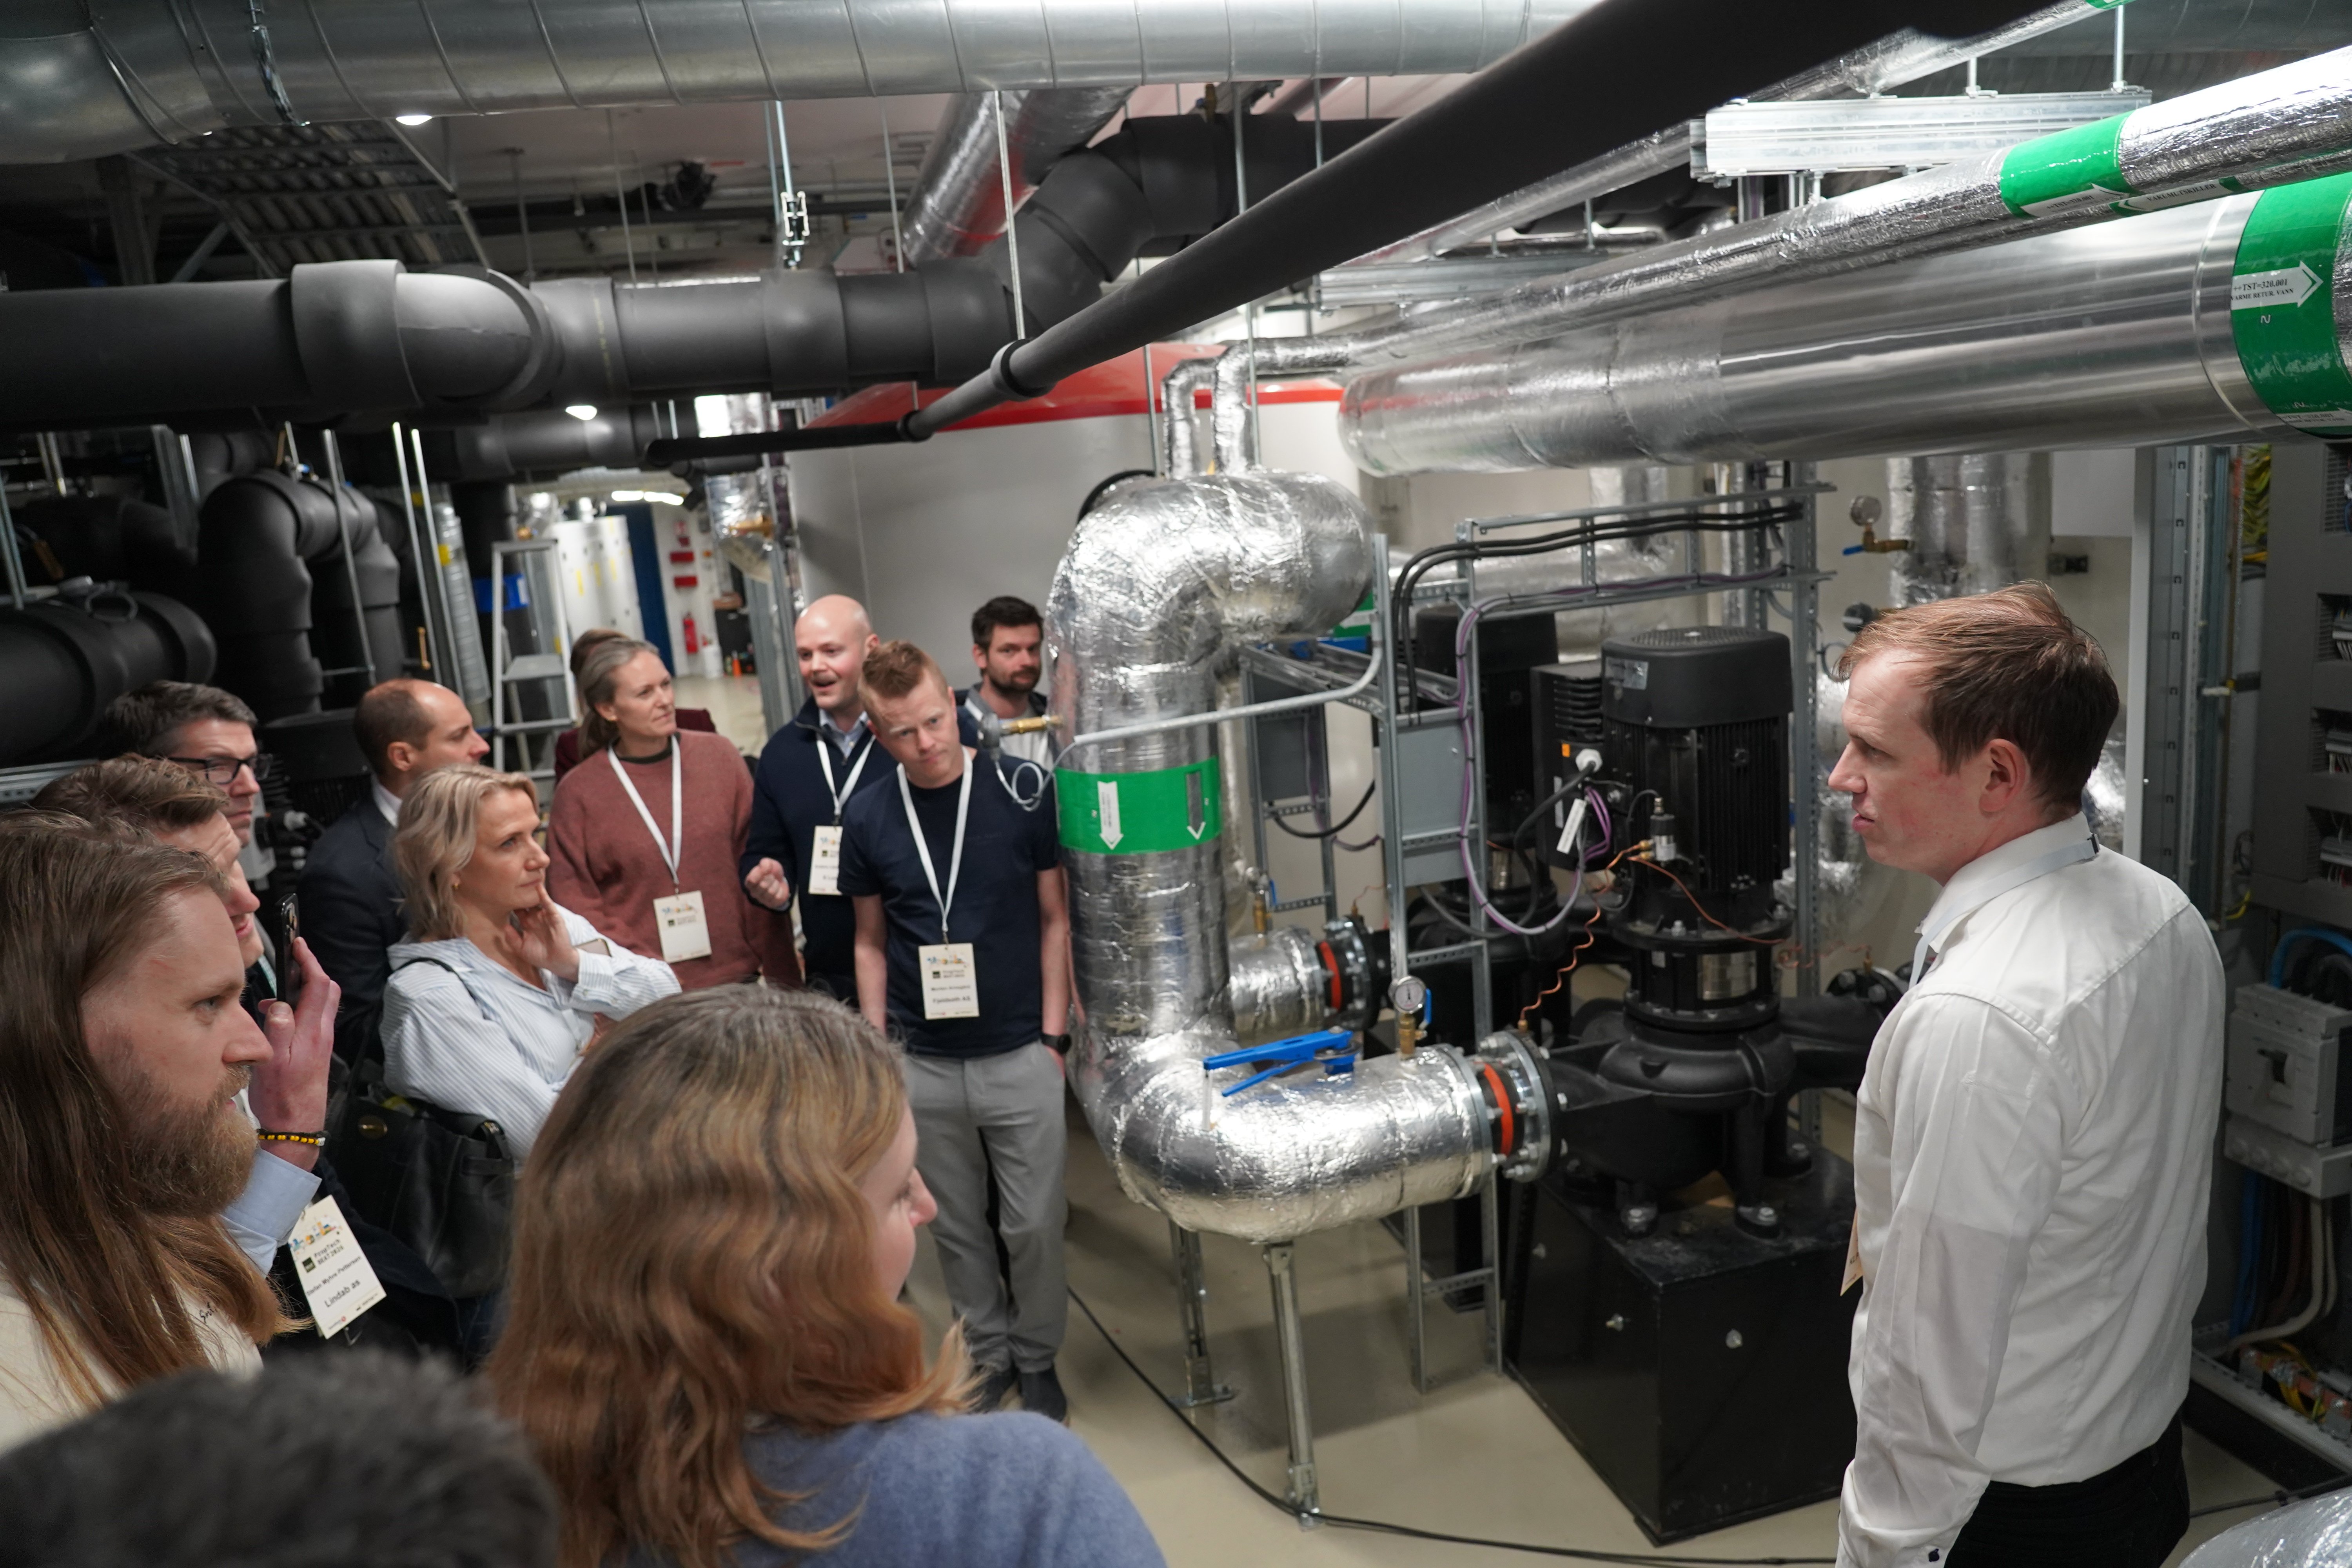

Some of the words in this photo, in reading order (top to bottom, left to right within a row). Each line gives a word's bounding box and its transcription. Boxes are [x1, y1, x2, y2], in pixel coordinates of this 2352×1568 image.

[2233, 278, 2288, 291] ++TST=320.001
[324, 1287, 350, 1307] Lindab
[351, 1279, 361, 1289] as
